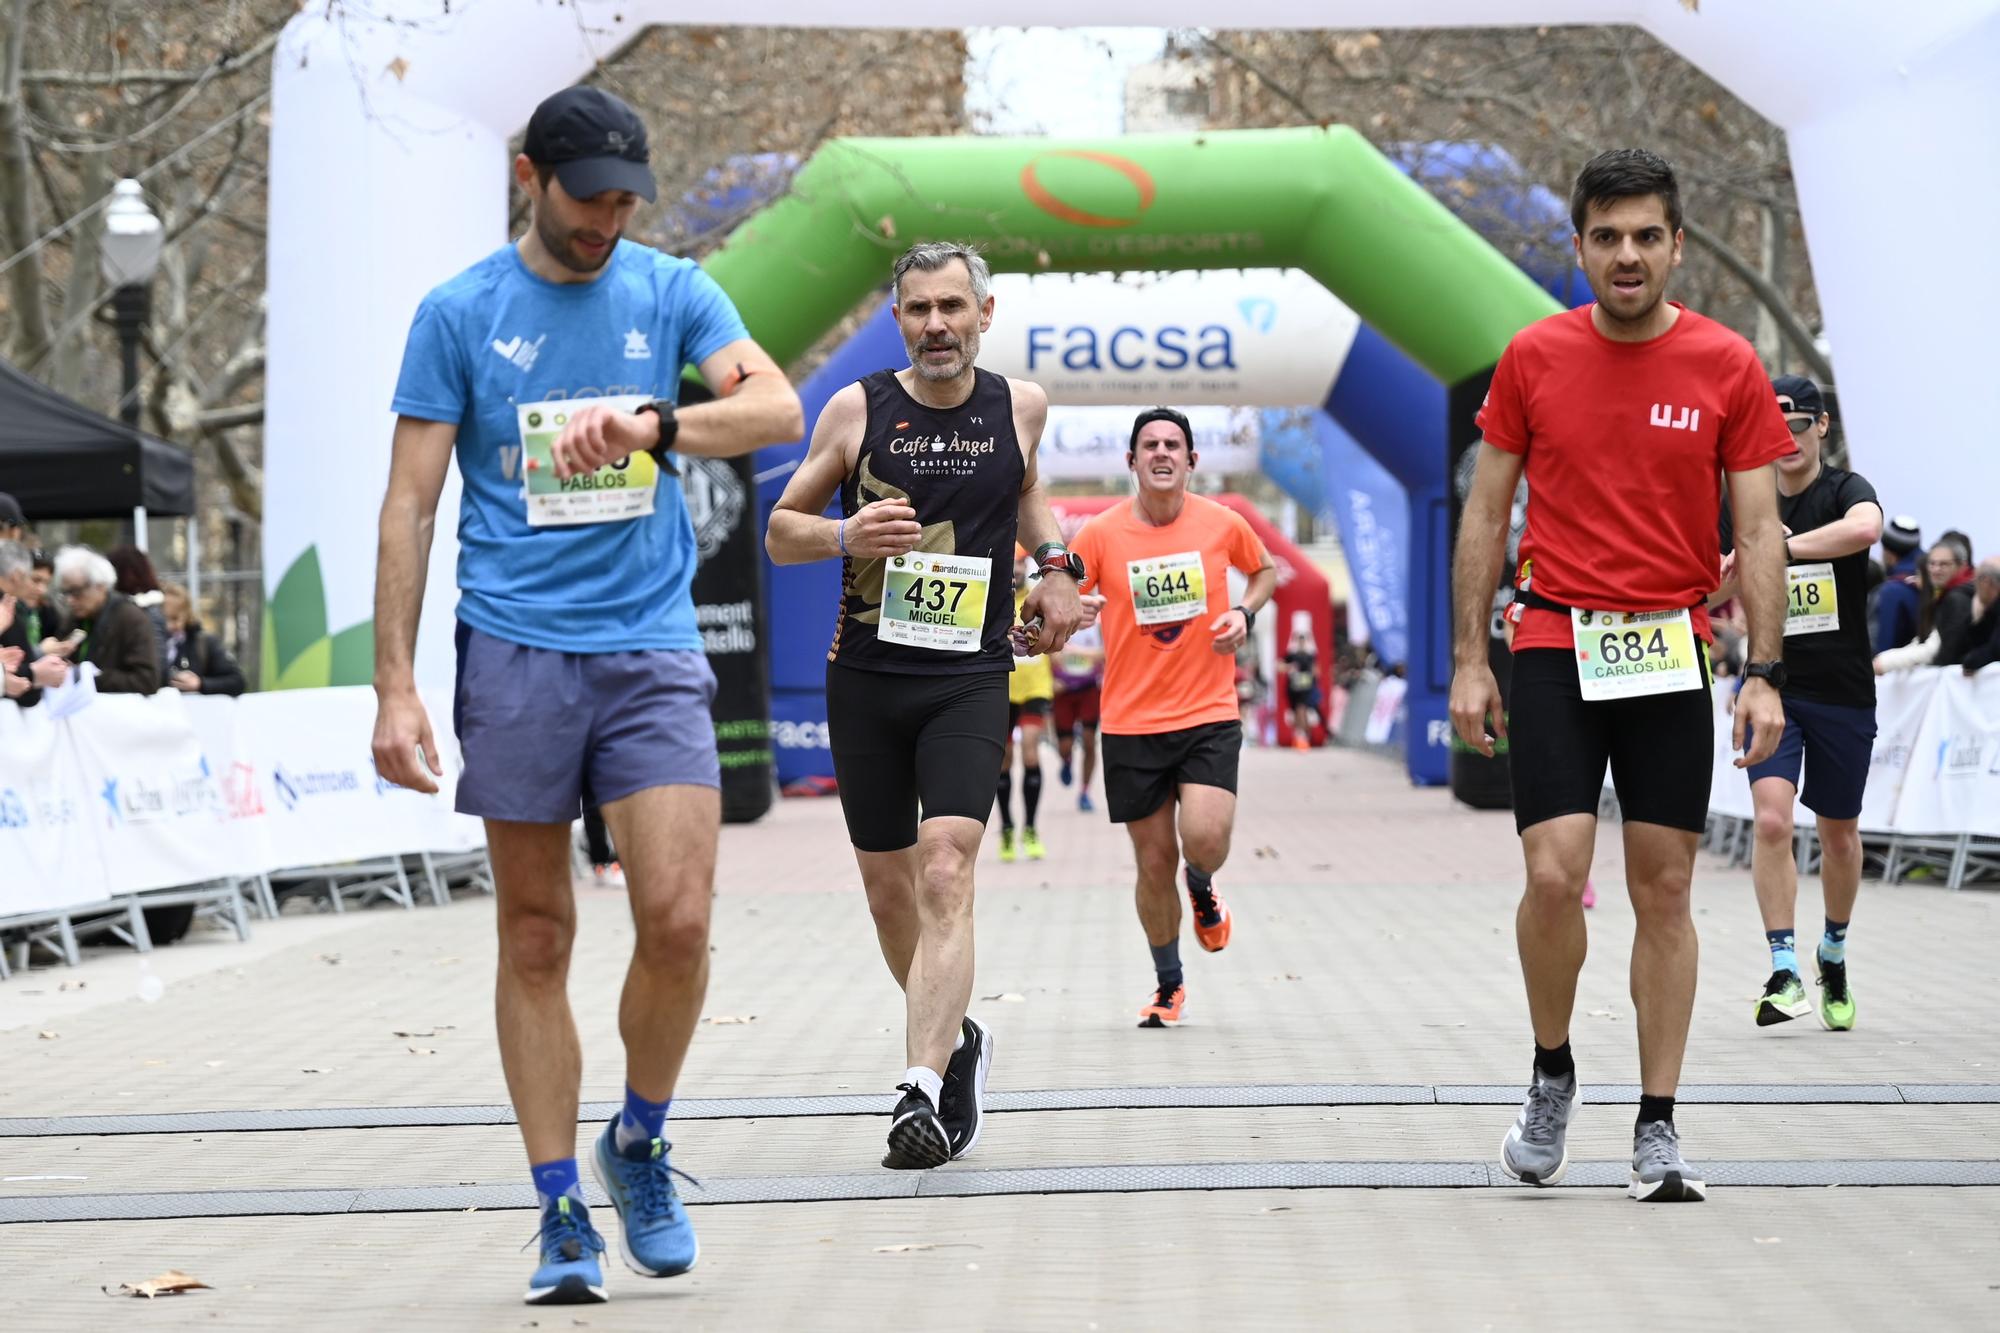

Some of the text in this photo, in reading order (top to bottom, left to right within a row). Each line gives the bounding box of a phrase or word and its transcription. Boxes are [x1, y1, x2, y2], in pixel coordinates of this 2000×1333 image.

[1650, 403, 1700, 432] UJI
[889, 430, 995, 456] Café Àngel
[910, 459, 977, 467] Castellón
[560, 473, 626, 491] PABLOS
[903, 577, 968, 613] 437
[1146, 571, 1189, 598] 644
[1787, 583, 1820, 607] 18
[908, 610, 957, 626] MIGUEL
[1789, 607, 1810, 618] SAM
[1600, 628, 1669, 664] 684
[1594, 658, 1681, 678] CARLOS UJI
